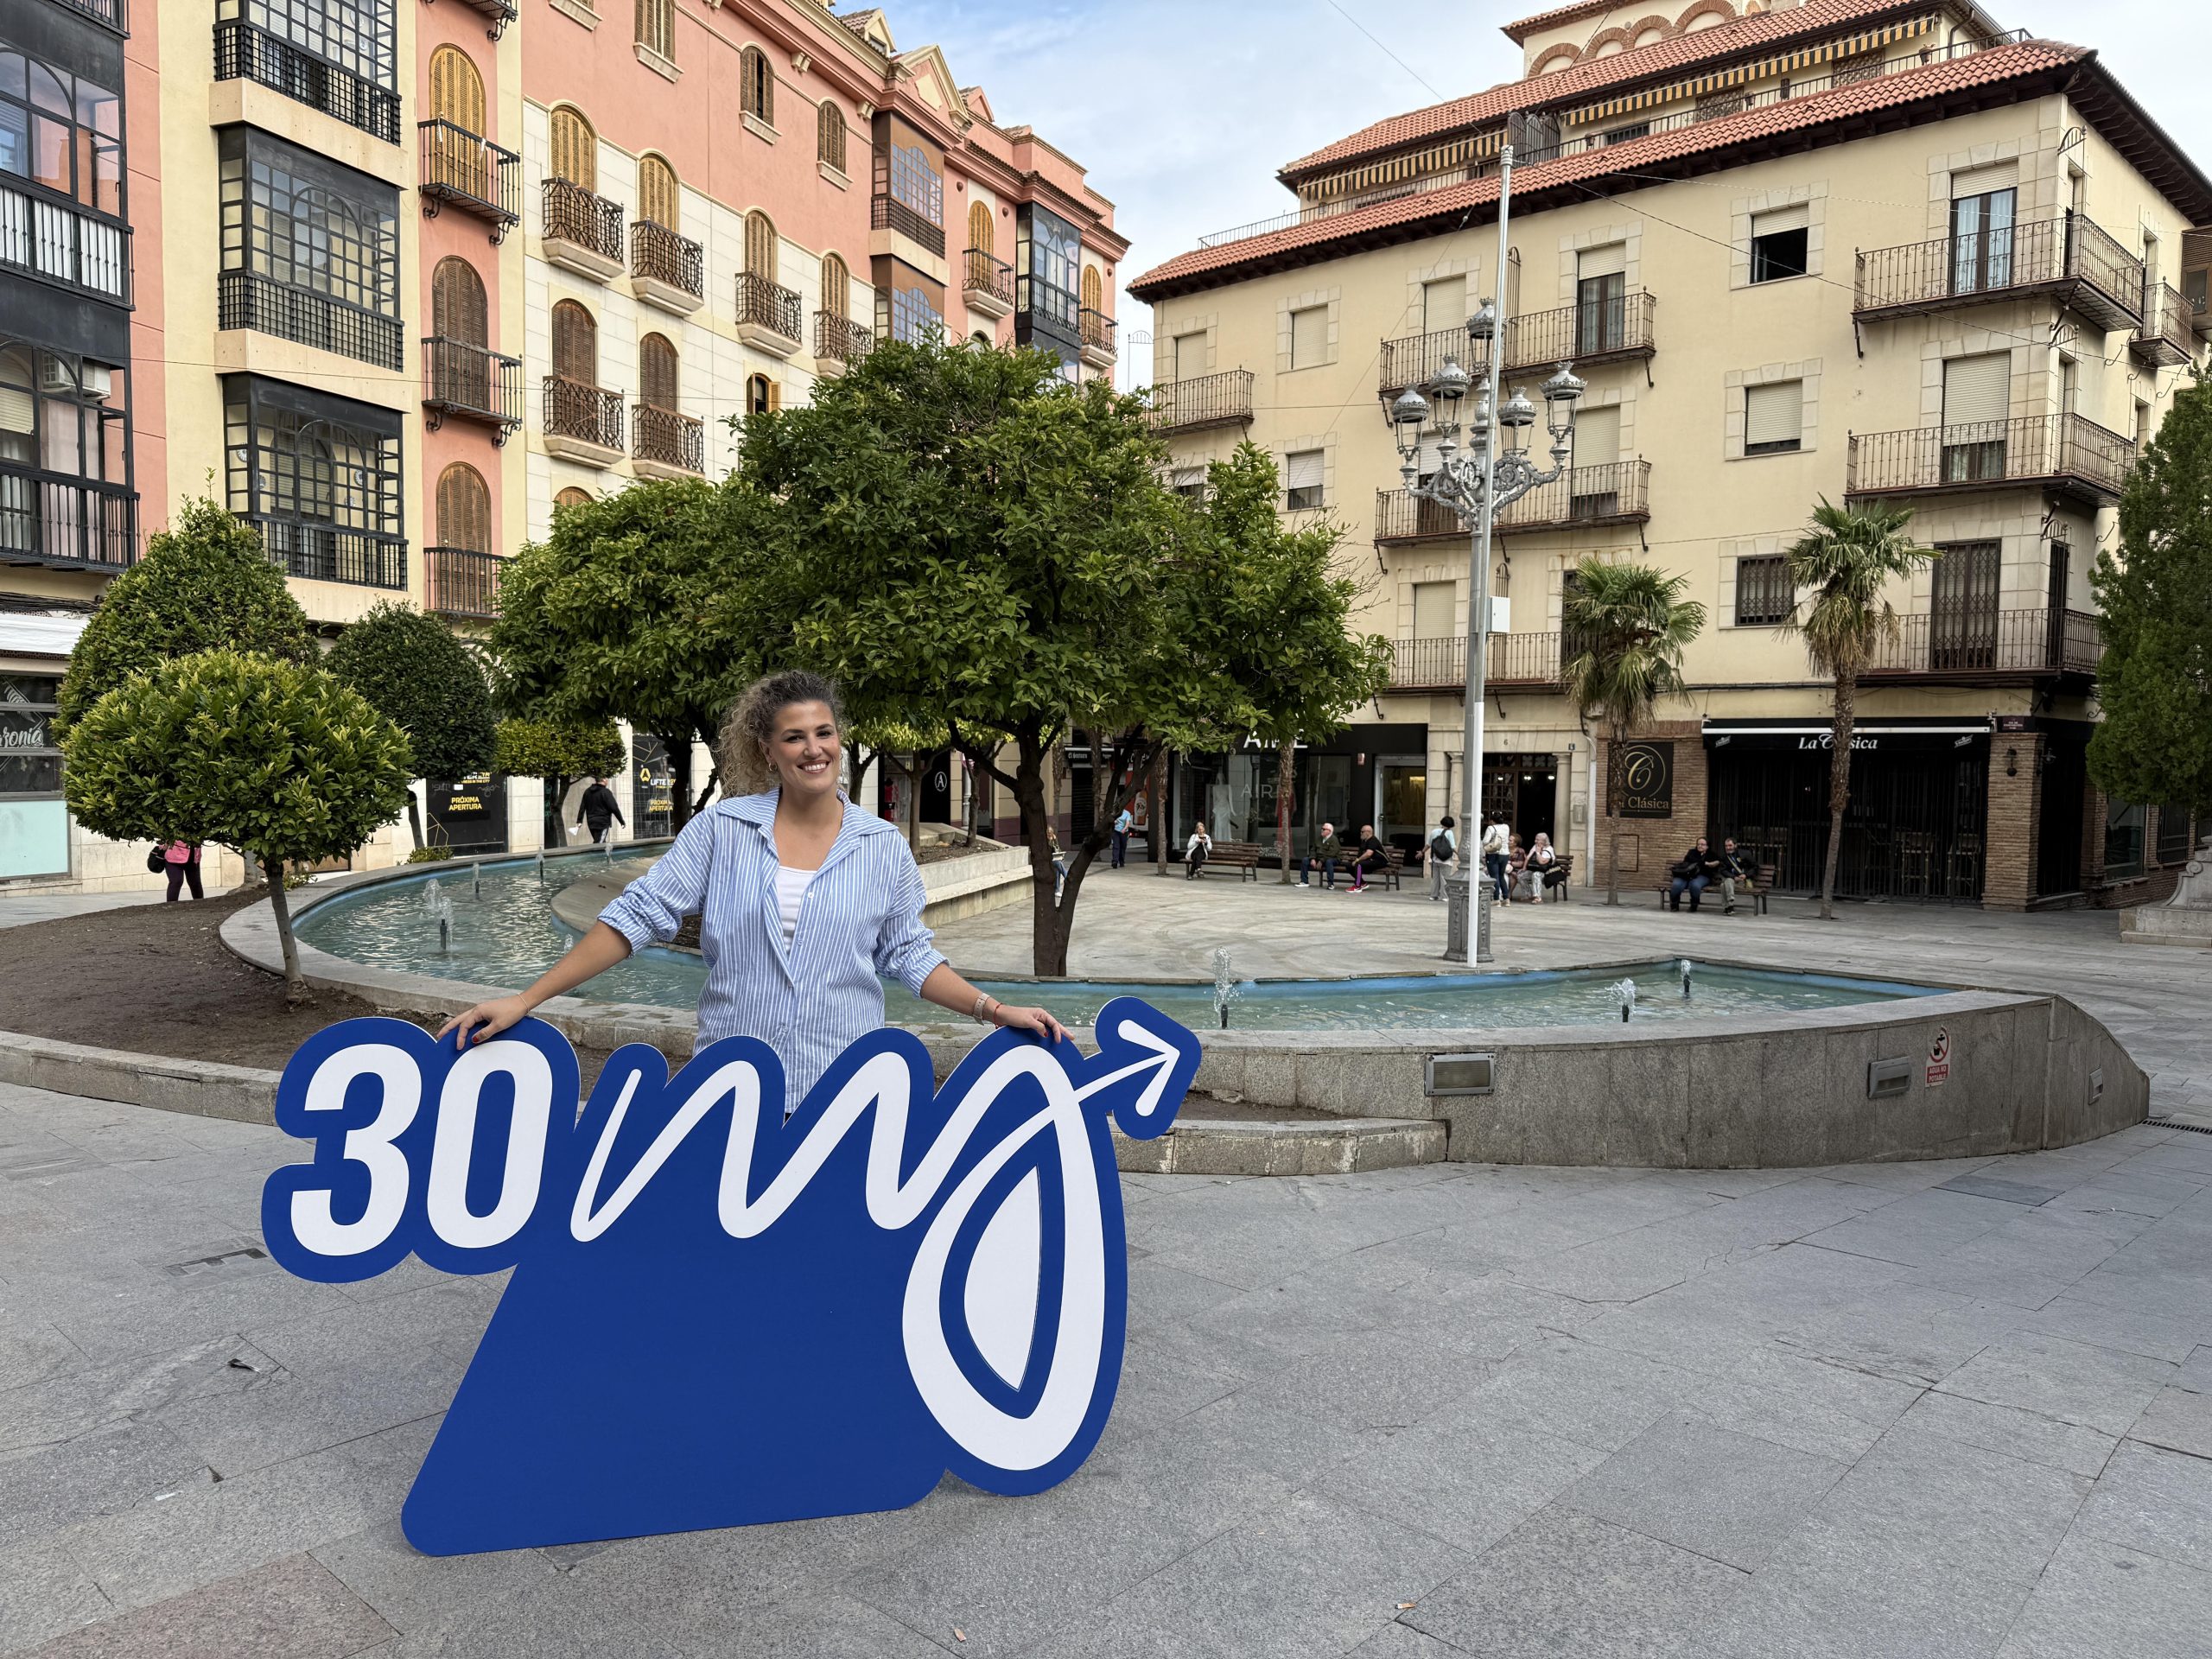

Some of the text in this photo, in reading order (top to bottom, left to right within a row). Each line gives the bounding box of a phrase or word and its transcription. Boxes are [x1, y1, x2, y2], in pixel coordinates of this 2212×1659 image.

[0, 727, 44, 748] zonia
[1798, 734, 1878, 750] La Csica
[1241, 784, 1281, 798] AIR
[1628, 796, 1669, 810] Clásica
